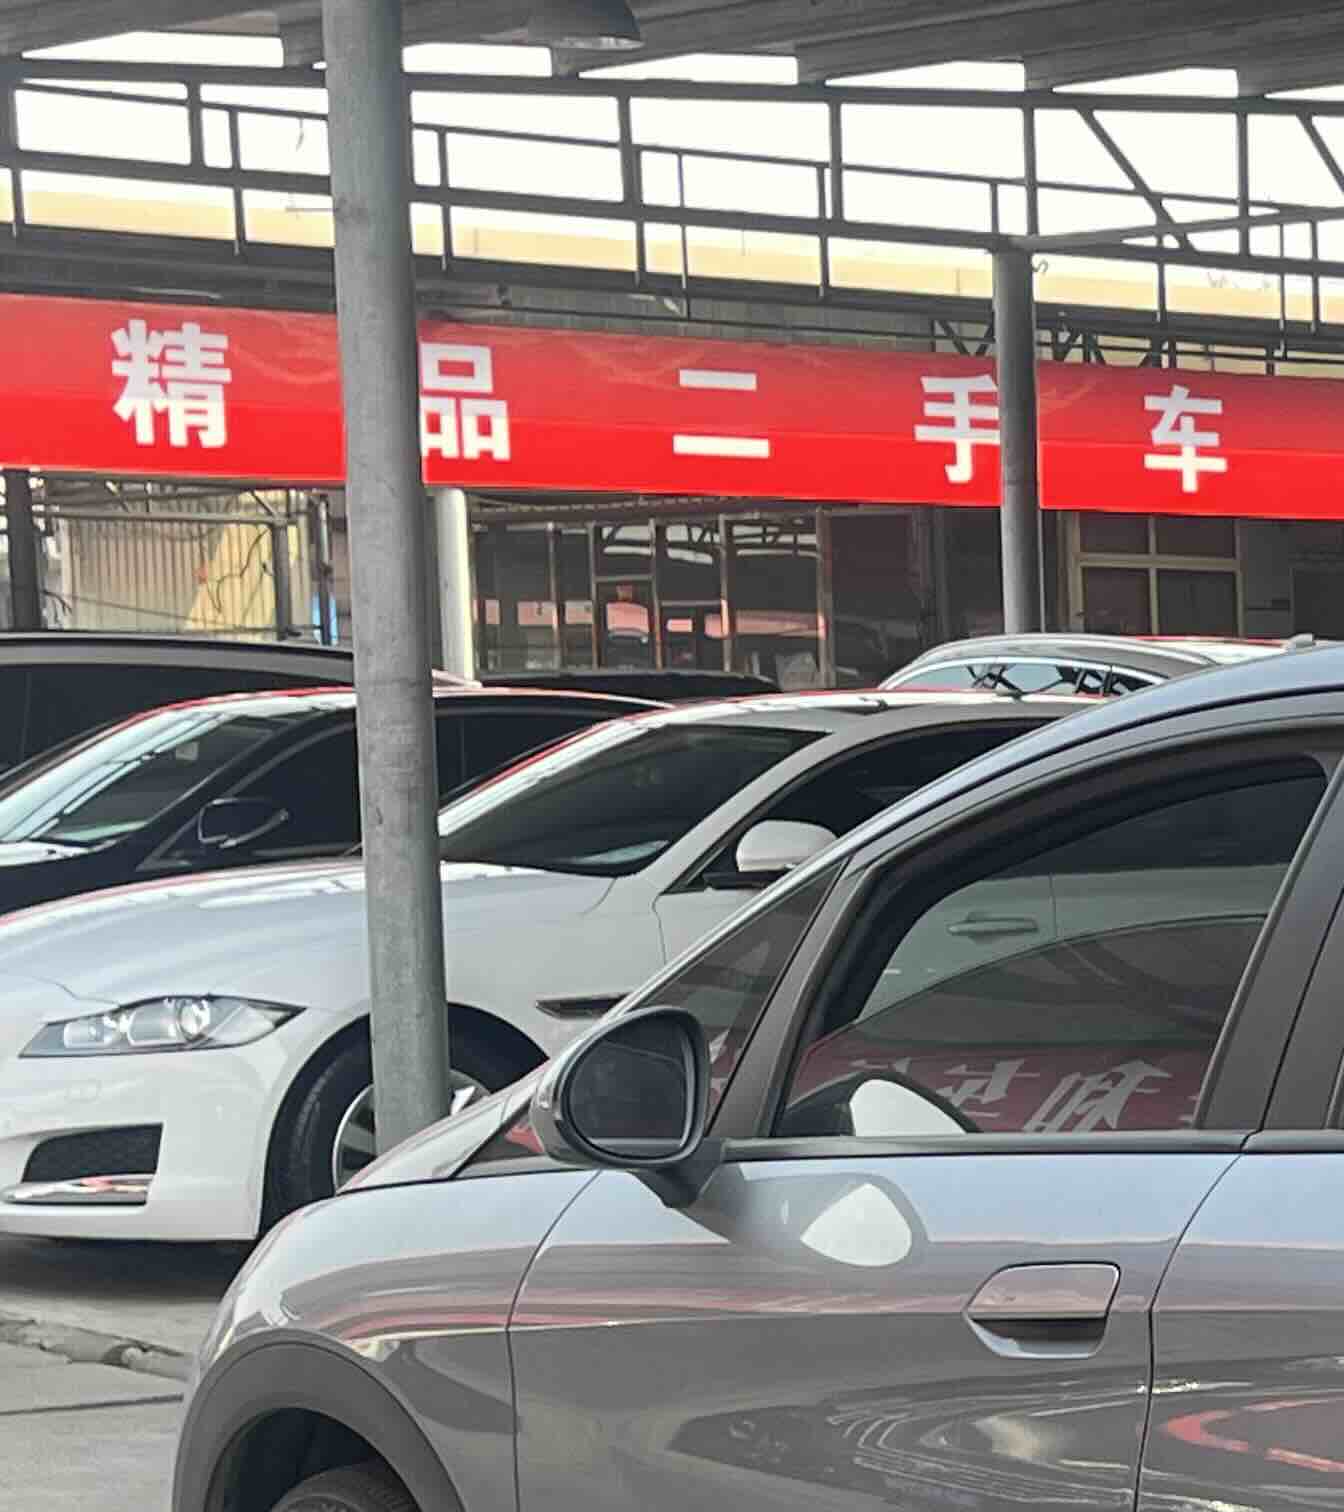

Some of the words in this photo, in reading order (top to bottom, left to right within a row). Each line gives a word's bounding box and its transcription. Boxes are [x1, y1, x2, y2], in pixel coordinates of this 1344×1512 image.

[111, 319, 1228, 493] 精品二手车
